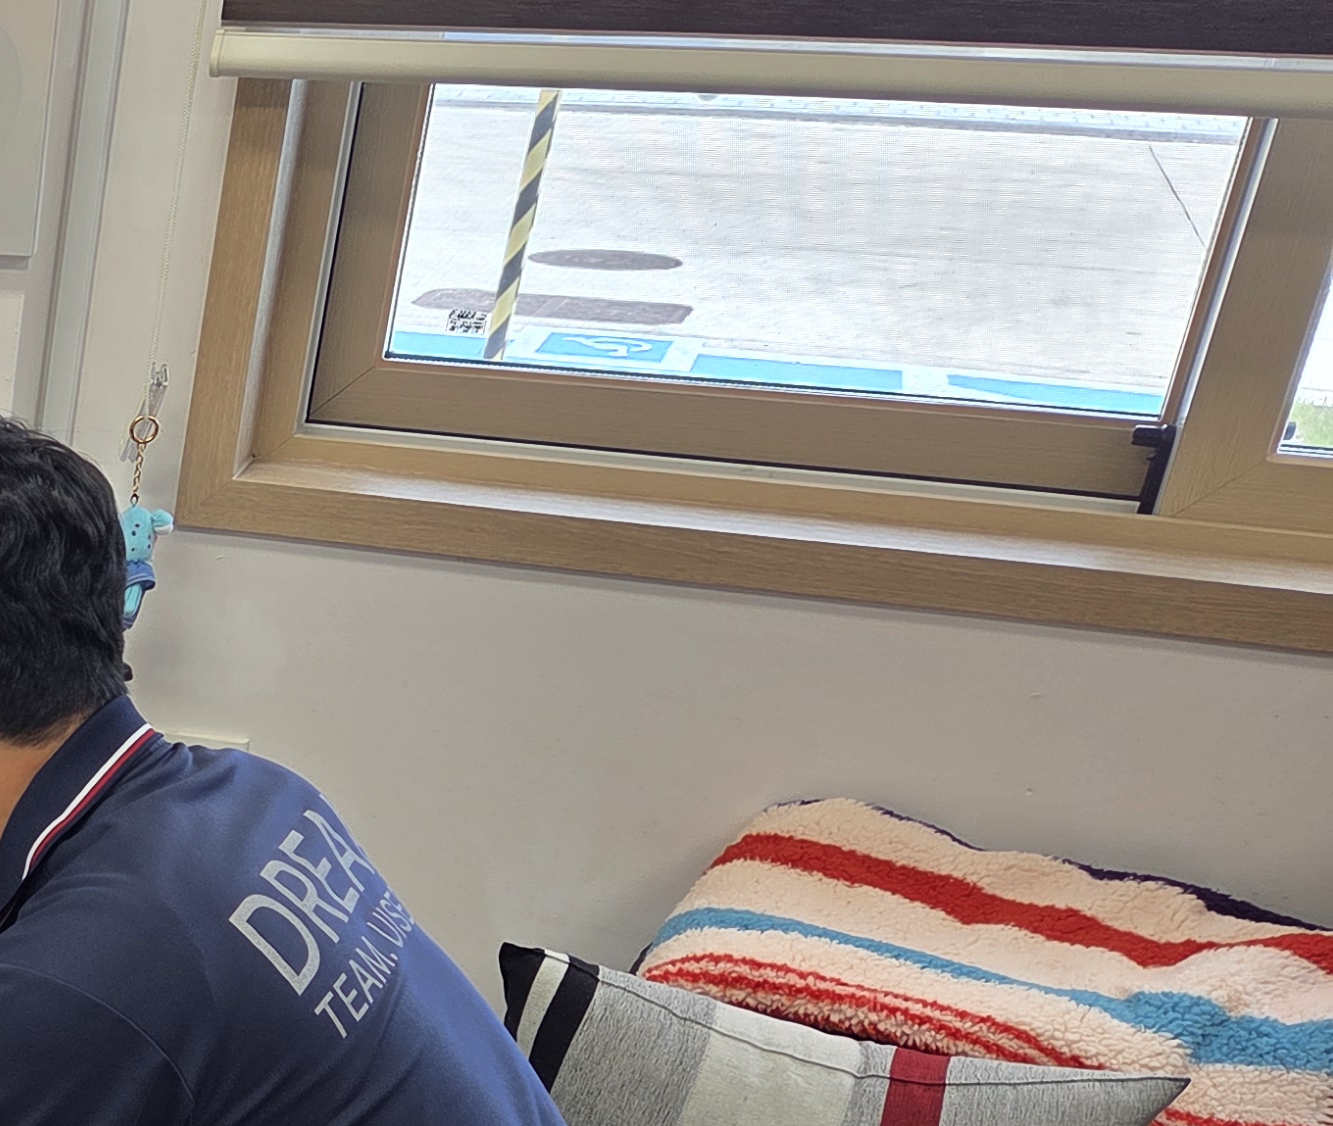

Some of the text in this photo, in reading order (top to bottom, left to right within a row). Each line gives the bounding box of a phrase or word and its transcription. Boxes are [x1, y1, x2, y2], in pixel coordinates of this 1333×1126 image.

[228, 794, 376, 996] DREA
[314, 886, 416, 1038] TEAM. UISE
